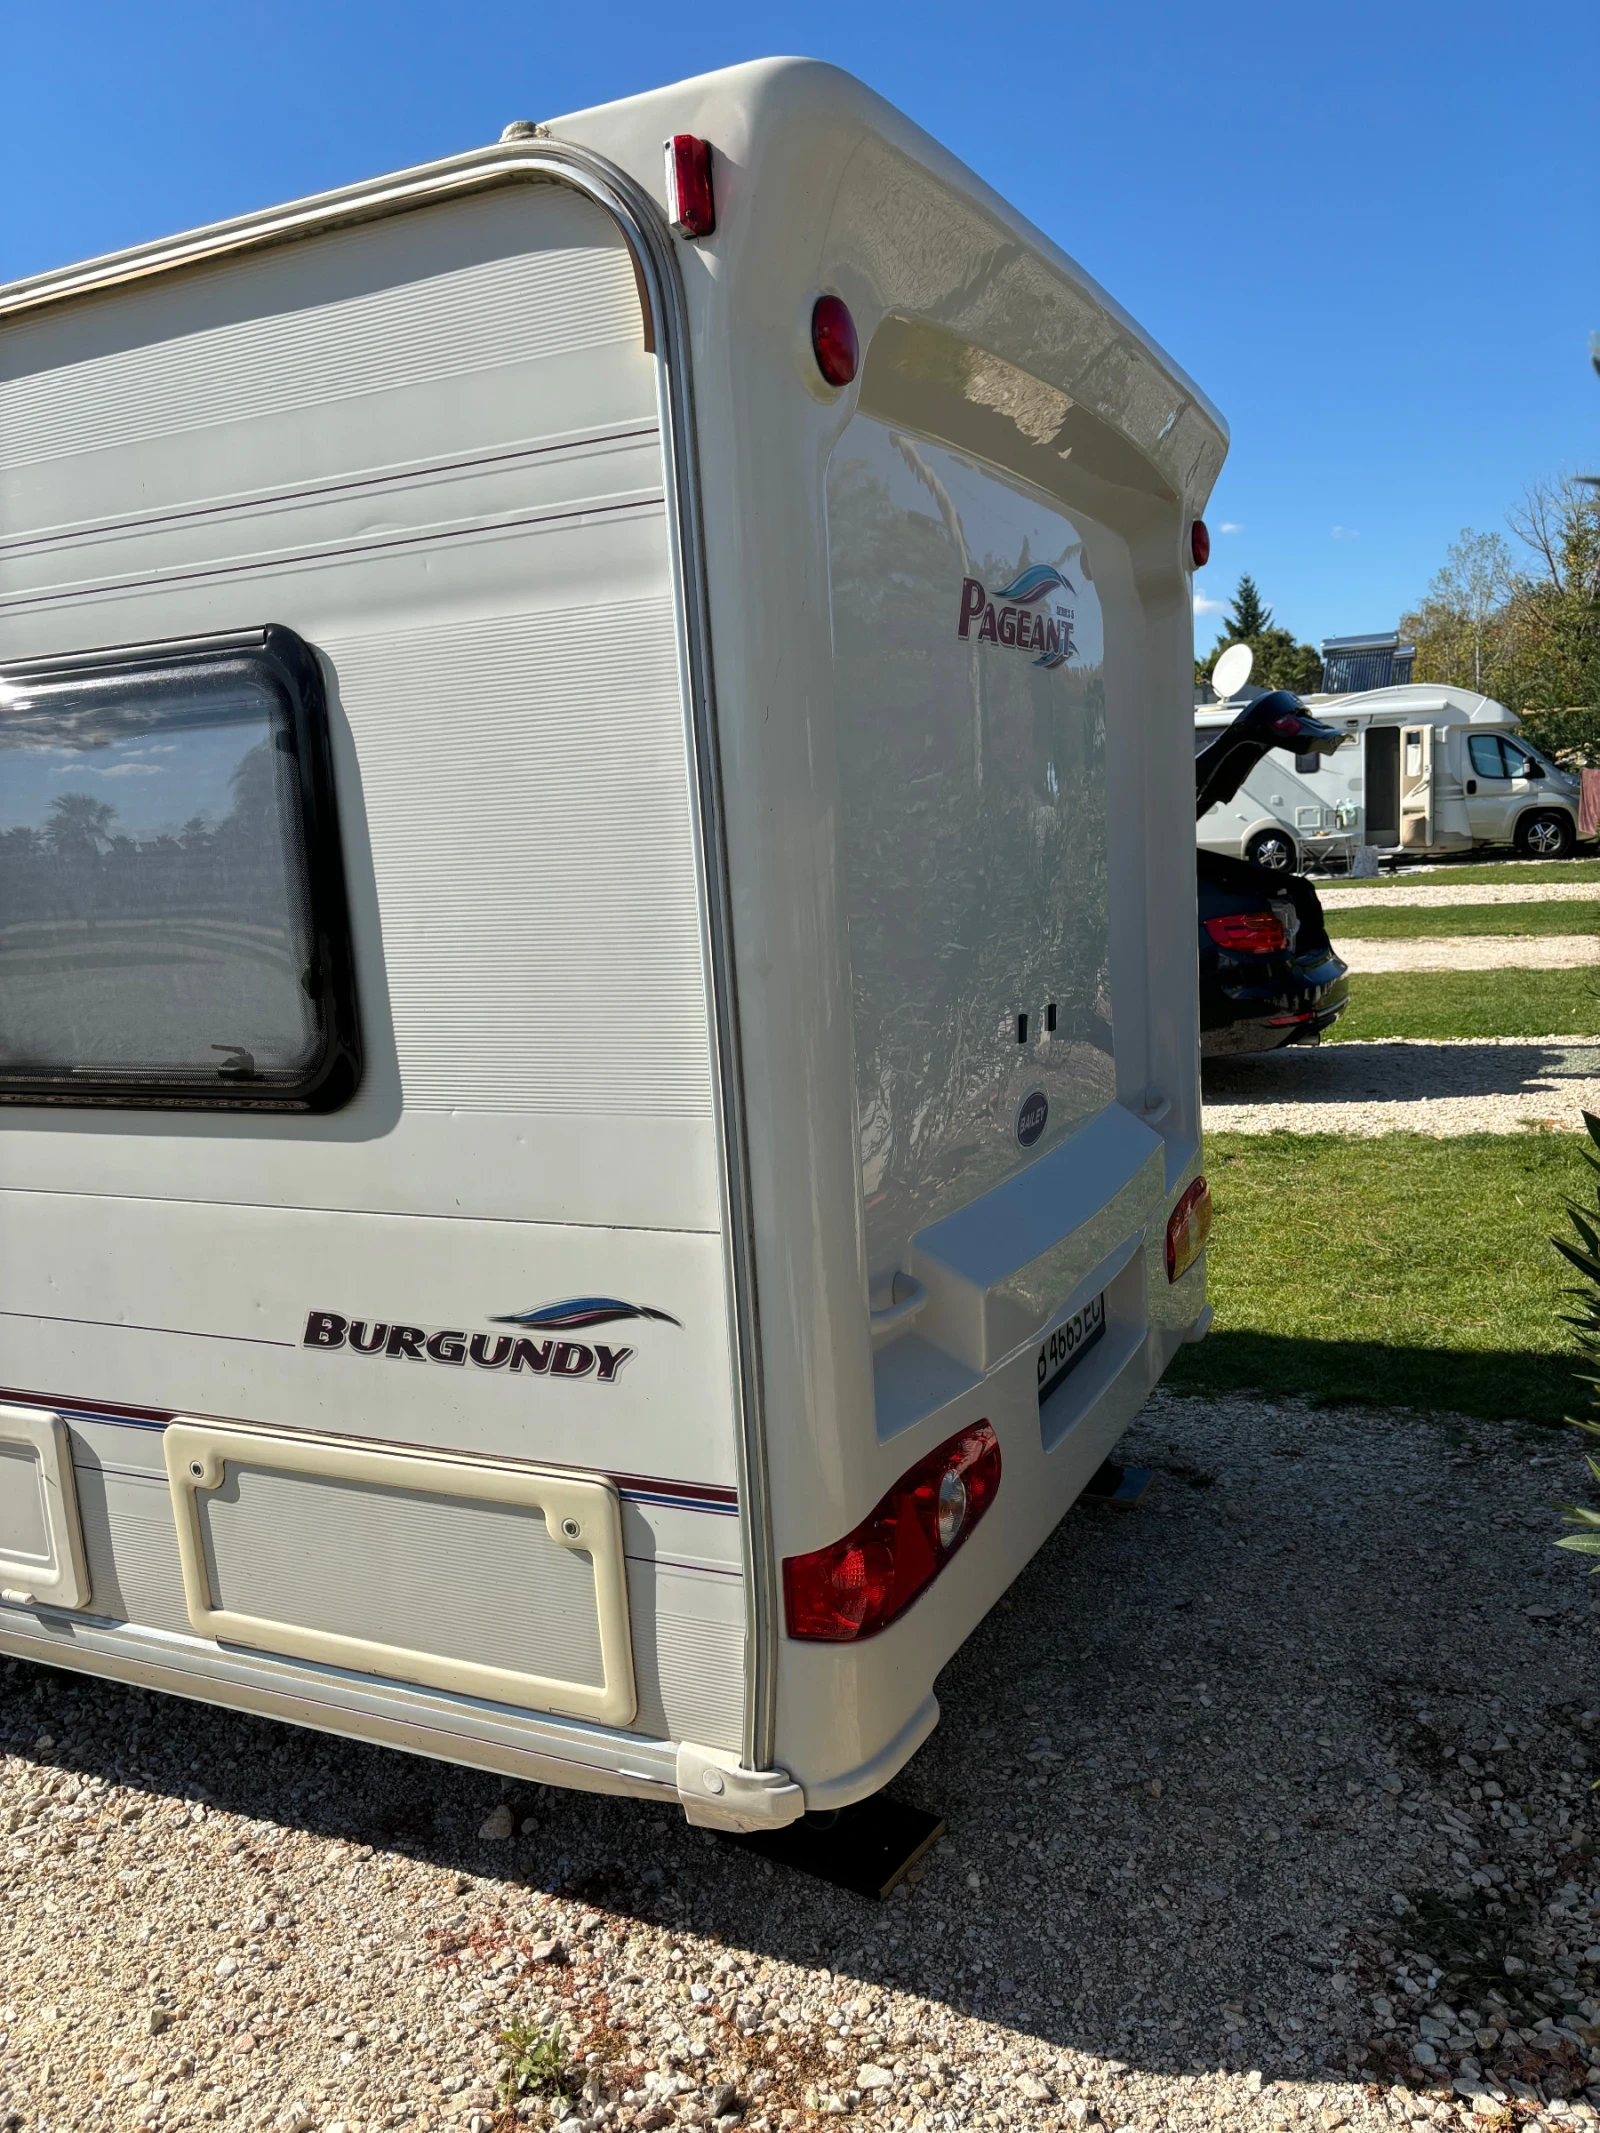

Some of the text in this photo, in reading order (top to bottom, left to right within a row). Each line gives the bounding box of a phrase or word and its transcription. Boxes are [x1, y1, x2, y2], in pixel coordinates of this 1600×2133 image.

[958, 577, 1075, 656] PAGEANT
[1019, 1105, 1047, 1134] BAILEY
[303, 1311, 632, 1381] BURGUNDY
